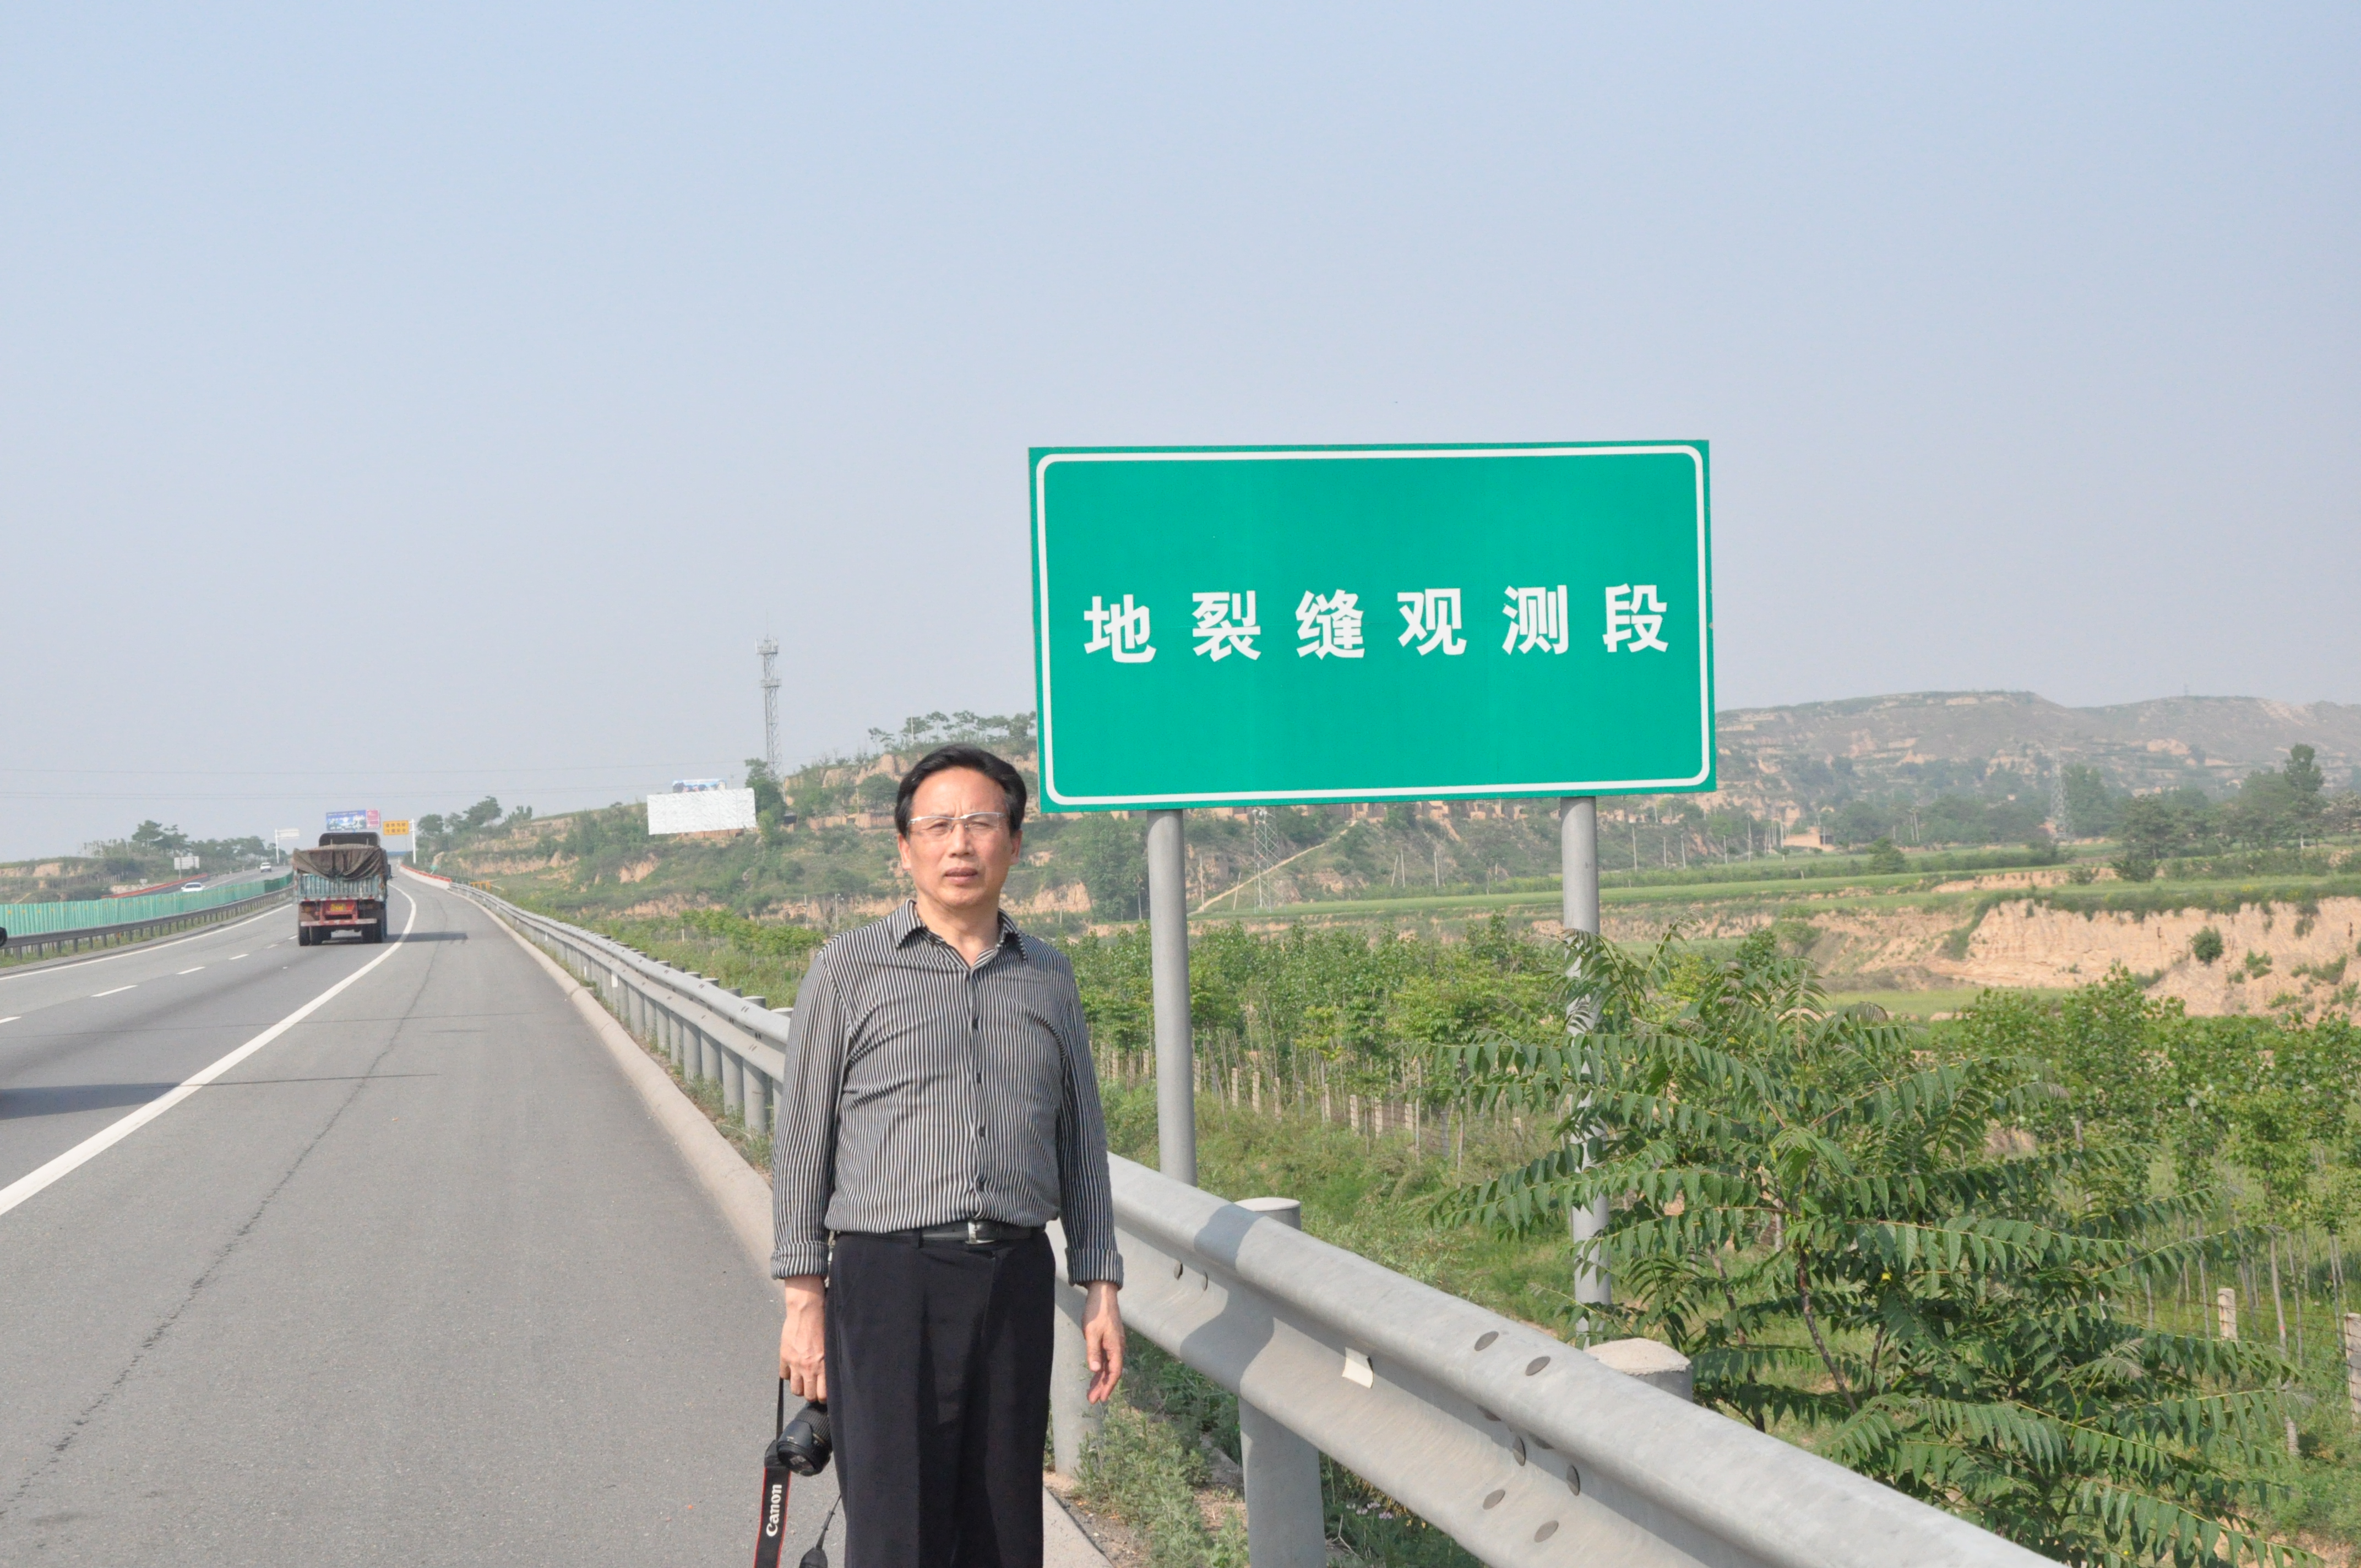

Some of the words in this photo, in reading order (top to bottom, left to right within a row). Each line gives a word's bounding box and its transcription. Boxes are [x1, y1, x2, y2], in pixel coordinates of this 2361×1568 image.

[1084, 584, 1668, 663] 地裂缝观测段
[766, 1484, 782, 1537] Canon
